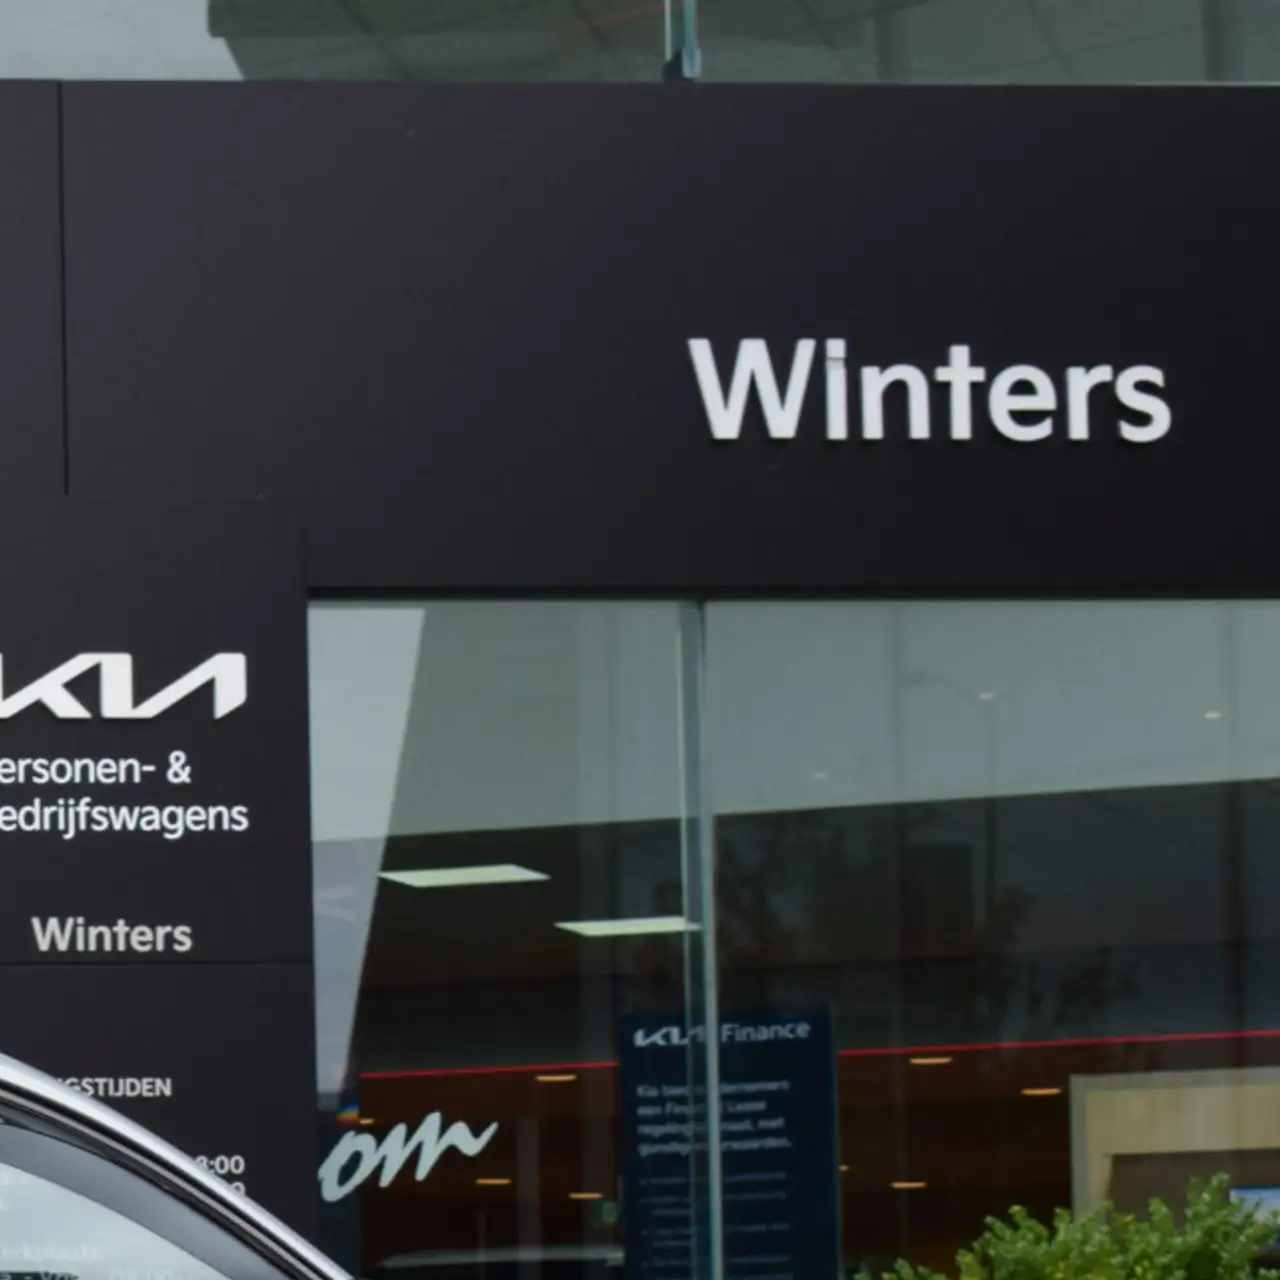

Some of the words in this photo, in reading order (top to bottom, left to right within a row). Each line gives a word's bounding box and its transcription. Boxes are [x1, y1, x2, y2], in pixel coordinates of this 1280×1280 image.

[687, 338, 1173, 443] Winters
[166, 750, 192, 784] &
[31, 916, 193, 952] Winters
[721, 1021, 812, 1043] Finance
